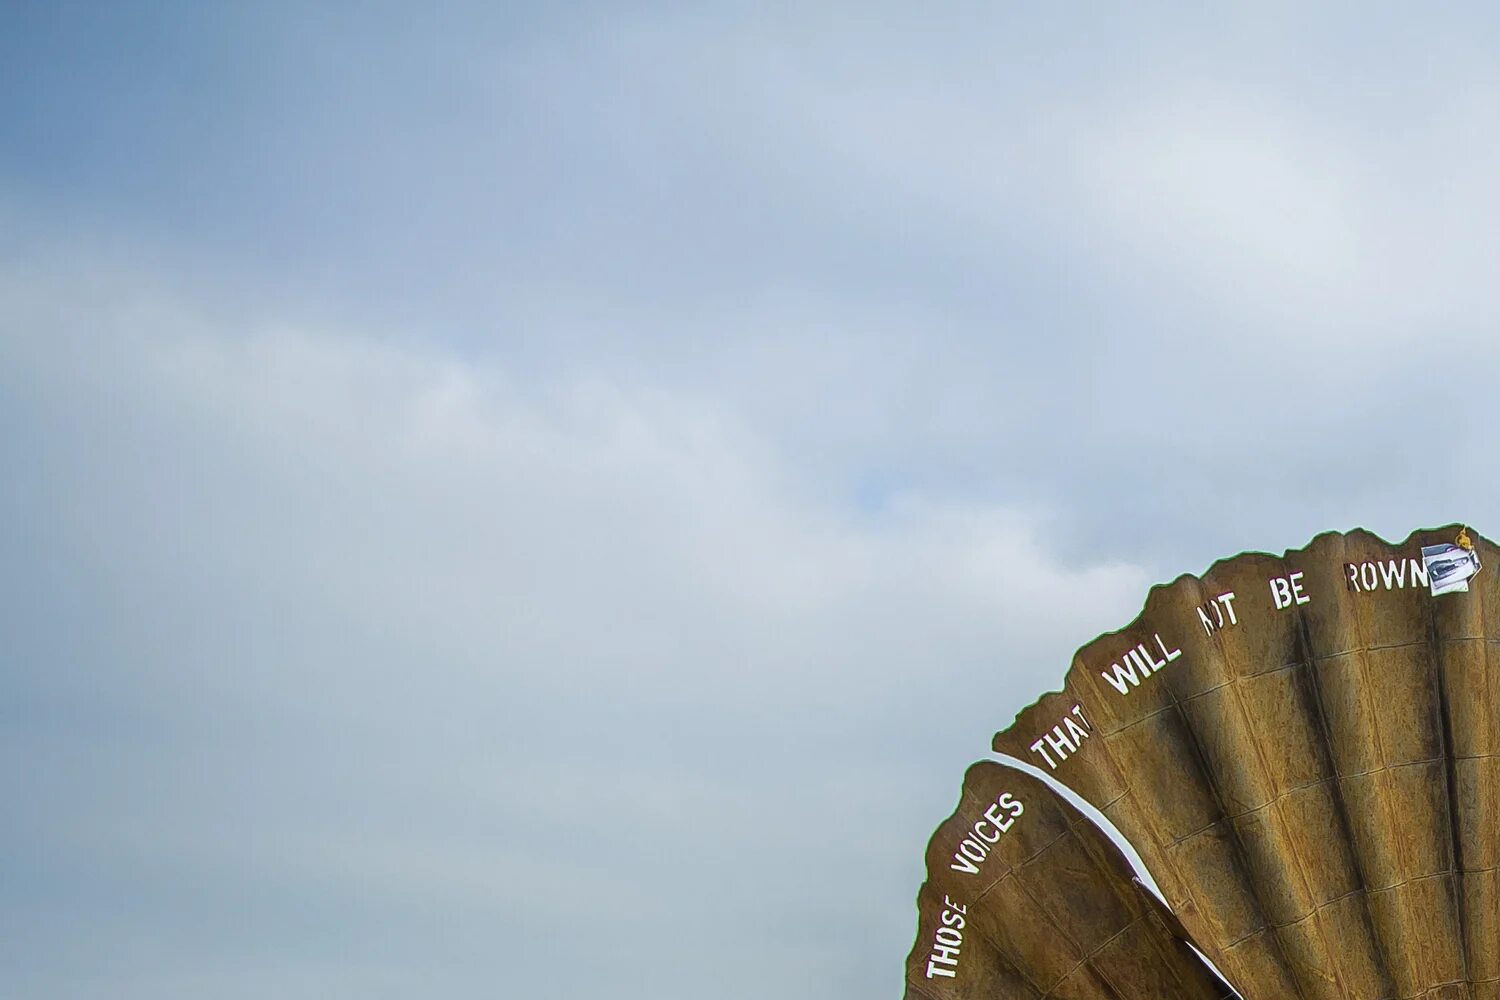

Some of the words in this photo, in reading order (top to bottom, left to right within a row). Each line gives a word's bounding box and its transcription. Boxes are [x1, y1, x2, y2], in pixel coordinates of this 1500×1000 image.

[926, 894, 967, 979] THOSE
[950, 792, 1024, 875] VOICES
[1030, 704, 1093, 770] THAT
[1101, 633, 1182, 696] WILL
[1269, 571, 1311, 610] BE
